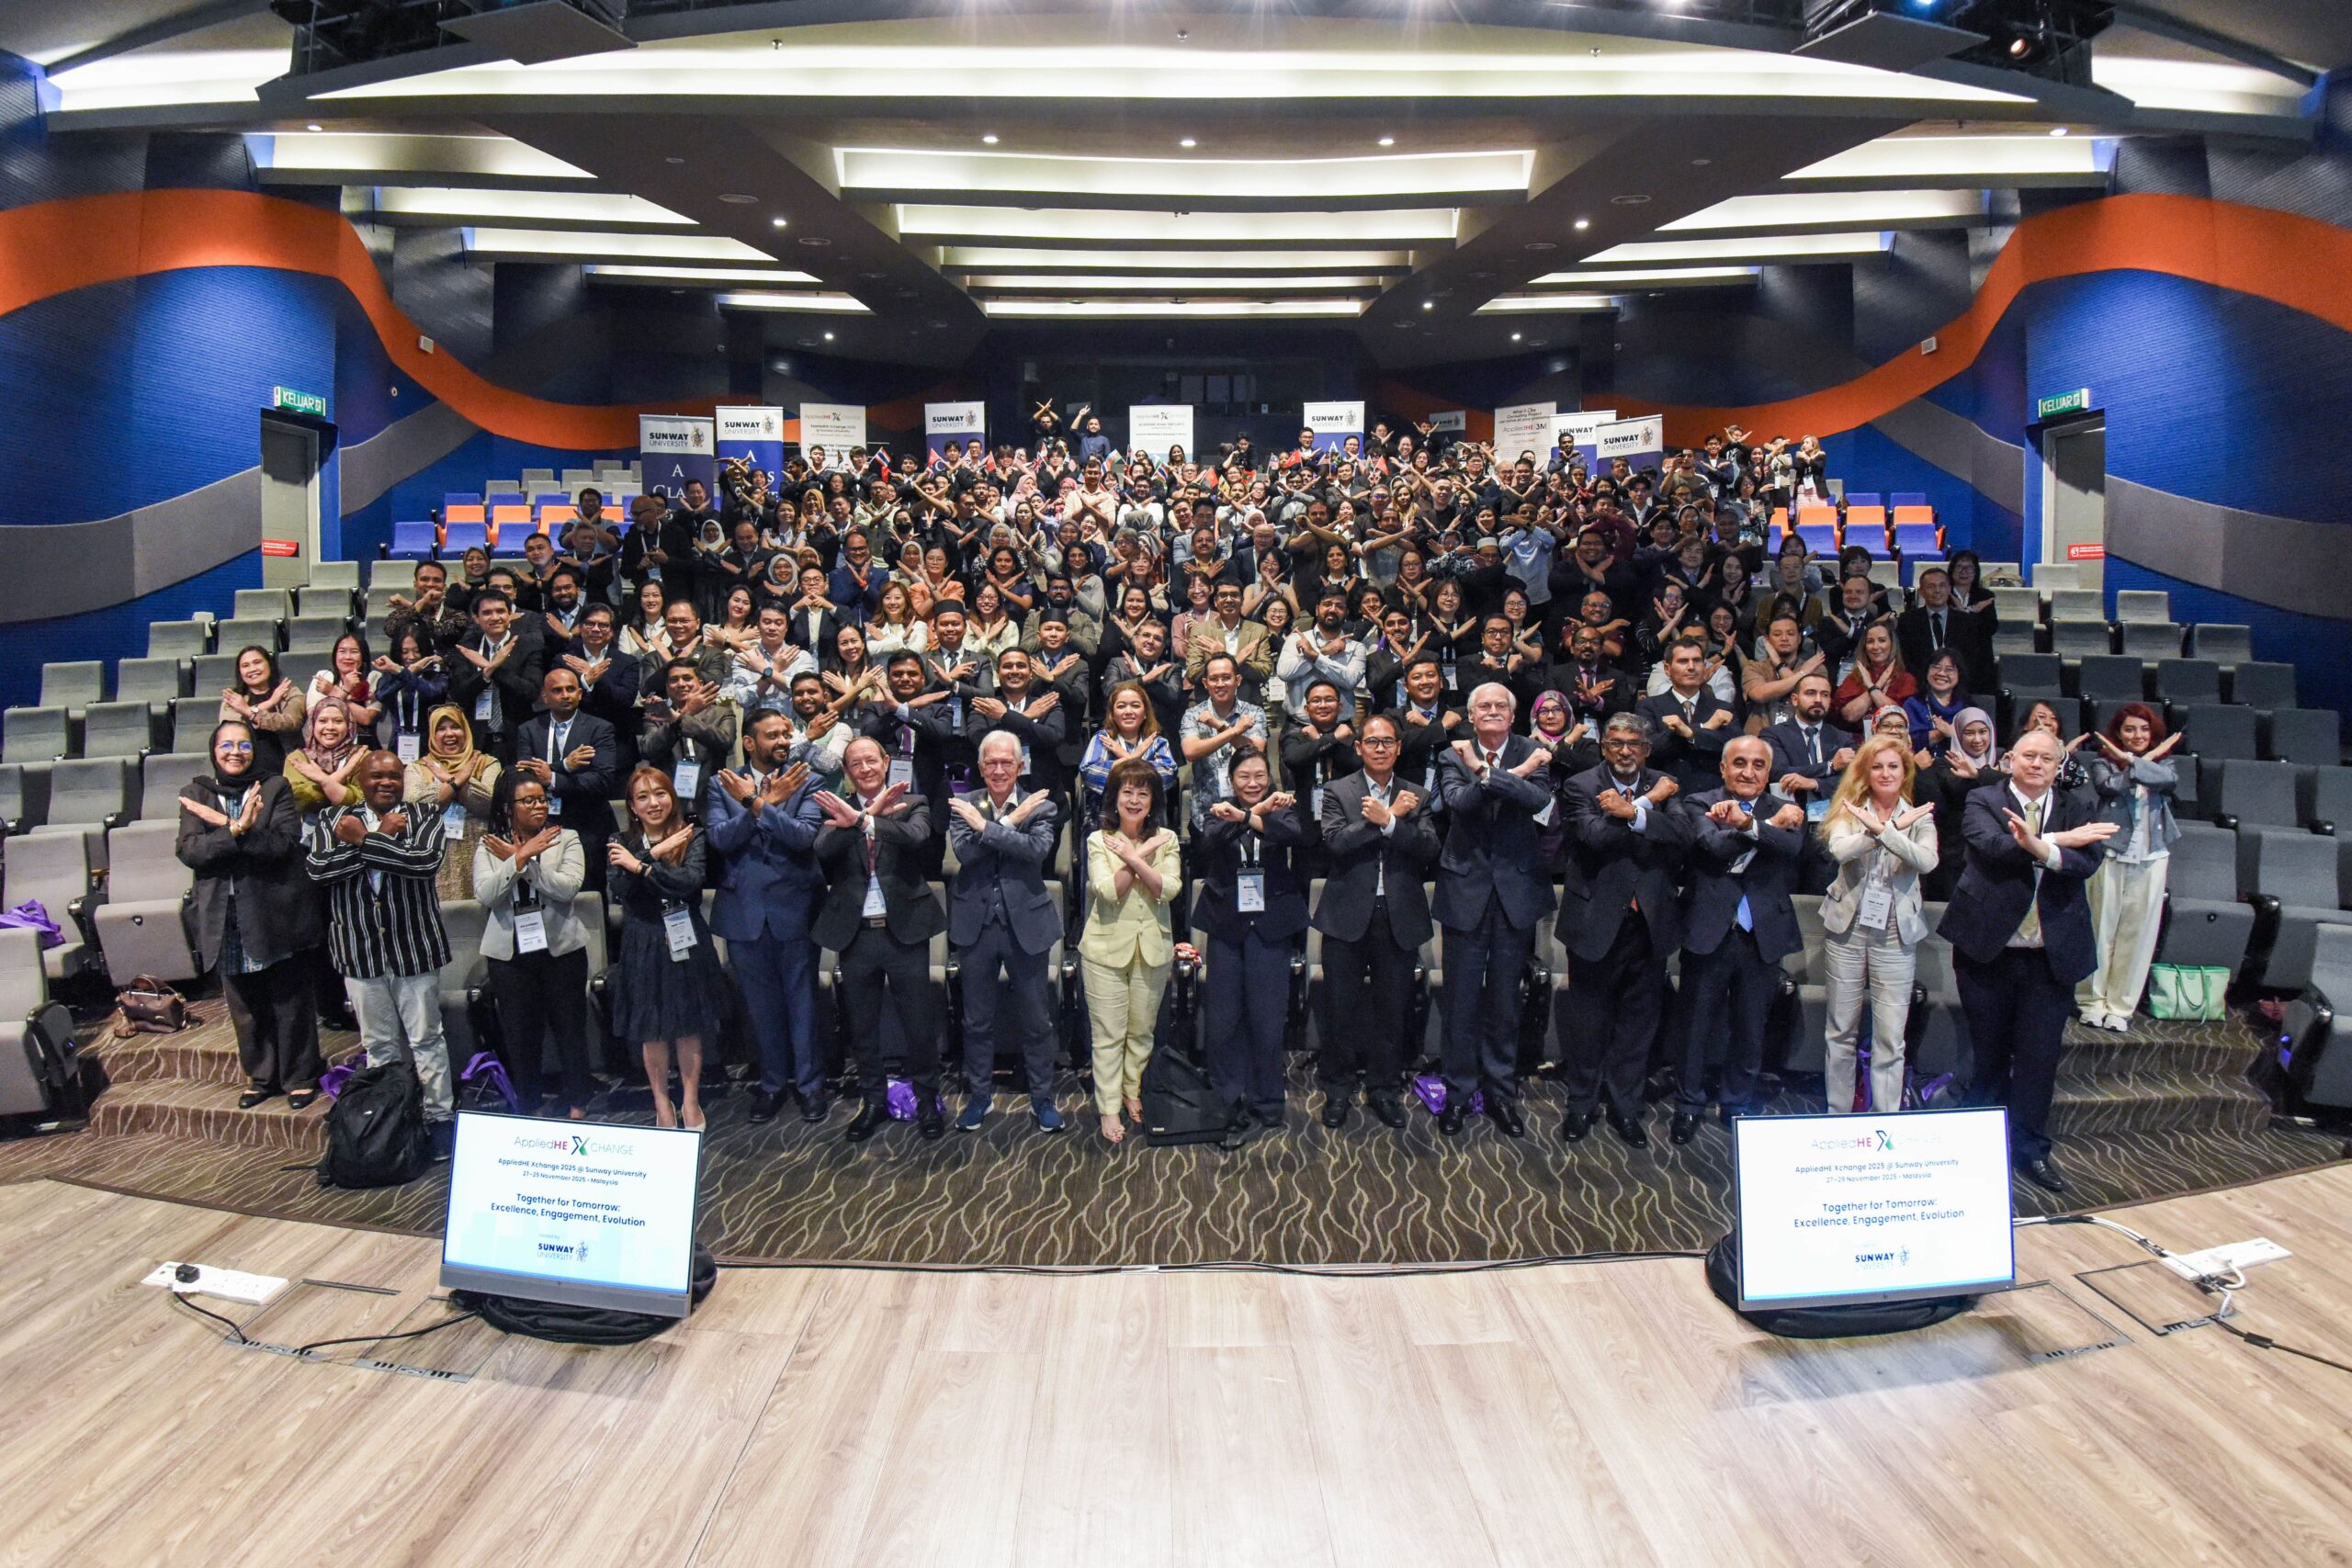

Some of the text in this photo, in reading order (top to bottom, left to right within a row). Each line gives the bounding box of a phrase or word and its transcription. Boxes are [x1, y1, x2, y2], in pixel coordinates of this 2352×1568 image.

[282, 390, 314, 410] KELUAR
[2041, 395, 2073, 412] KELUAR
[650, 432, 688, 441] SUNWAY
[1558, 426, 1593, 435] SUNWAY
[649, 440, 688, 448] UNIVERSITY
[1603, 434, 1639, 445] SUNWAY
[1603, 441, 1638, 452] UNIVERSITY
[746, 449, 757, 462] A
[672, 463, 684, 478] A
[652, 484, 686, 499] CLA
[514, 1135, 568, 1150] AppliedHE
[1811, 1137, 1871, 1150] AppliedHE
[498, 1157, 529, 1168] AppliedHE
[531, 1161, 560, 1171] Xchange
[585, 1167, 611, 1177] Sunway
[613, 1169, 647, 1179] University
[1795, 1165, 1833, 1174] AppliedHE
[1834, 1164, 1867, 1173] Xchange
[1868, 1162, 1885, 1170] 2025
[1894, 1161, 1923, 1169] Sunway
[1924, 1158, 1959, 1167] University
[540, 1173, 571, 1181] November
[590, 1178, 618, 1186] Malaysia
[1846, 1175, 1881, 1183] November
[1902, 1172, 1931, 1180] Malaysia
[516, 1193, 621, 1212] Together for Tomorrow:
[1822, 1199, 1938, 1214] Together for Tomorrow:
[491, 1202, 646, 1226] Excellence, Engagement, Evolution
[1793, 1209, 1964, 1228] Excellence, Engagement, Evolution
[537, 1243, 574, 1254] SUNWAY
[537, 1251, 573, 1261] UNIVERSITY
[1855, 1252, 1894, 1263] SUNWAY
